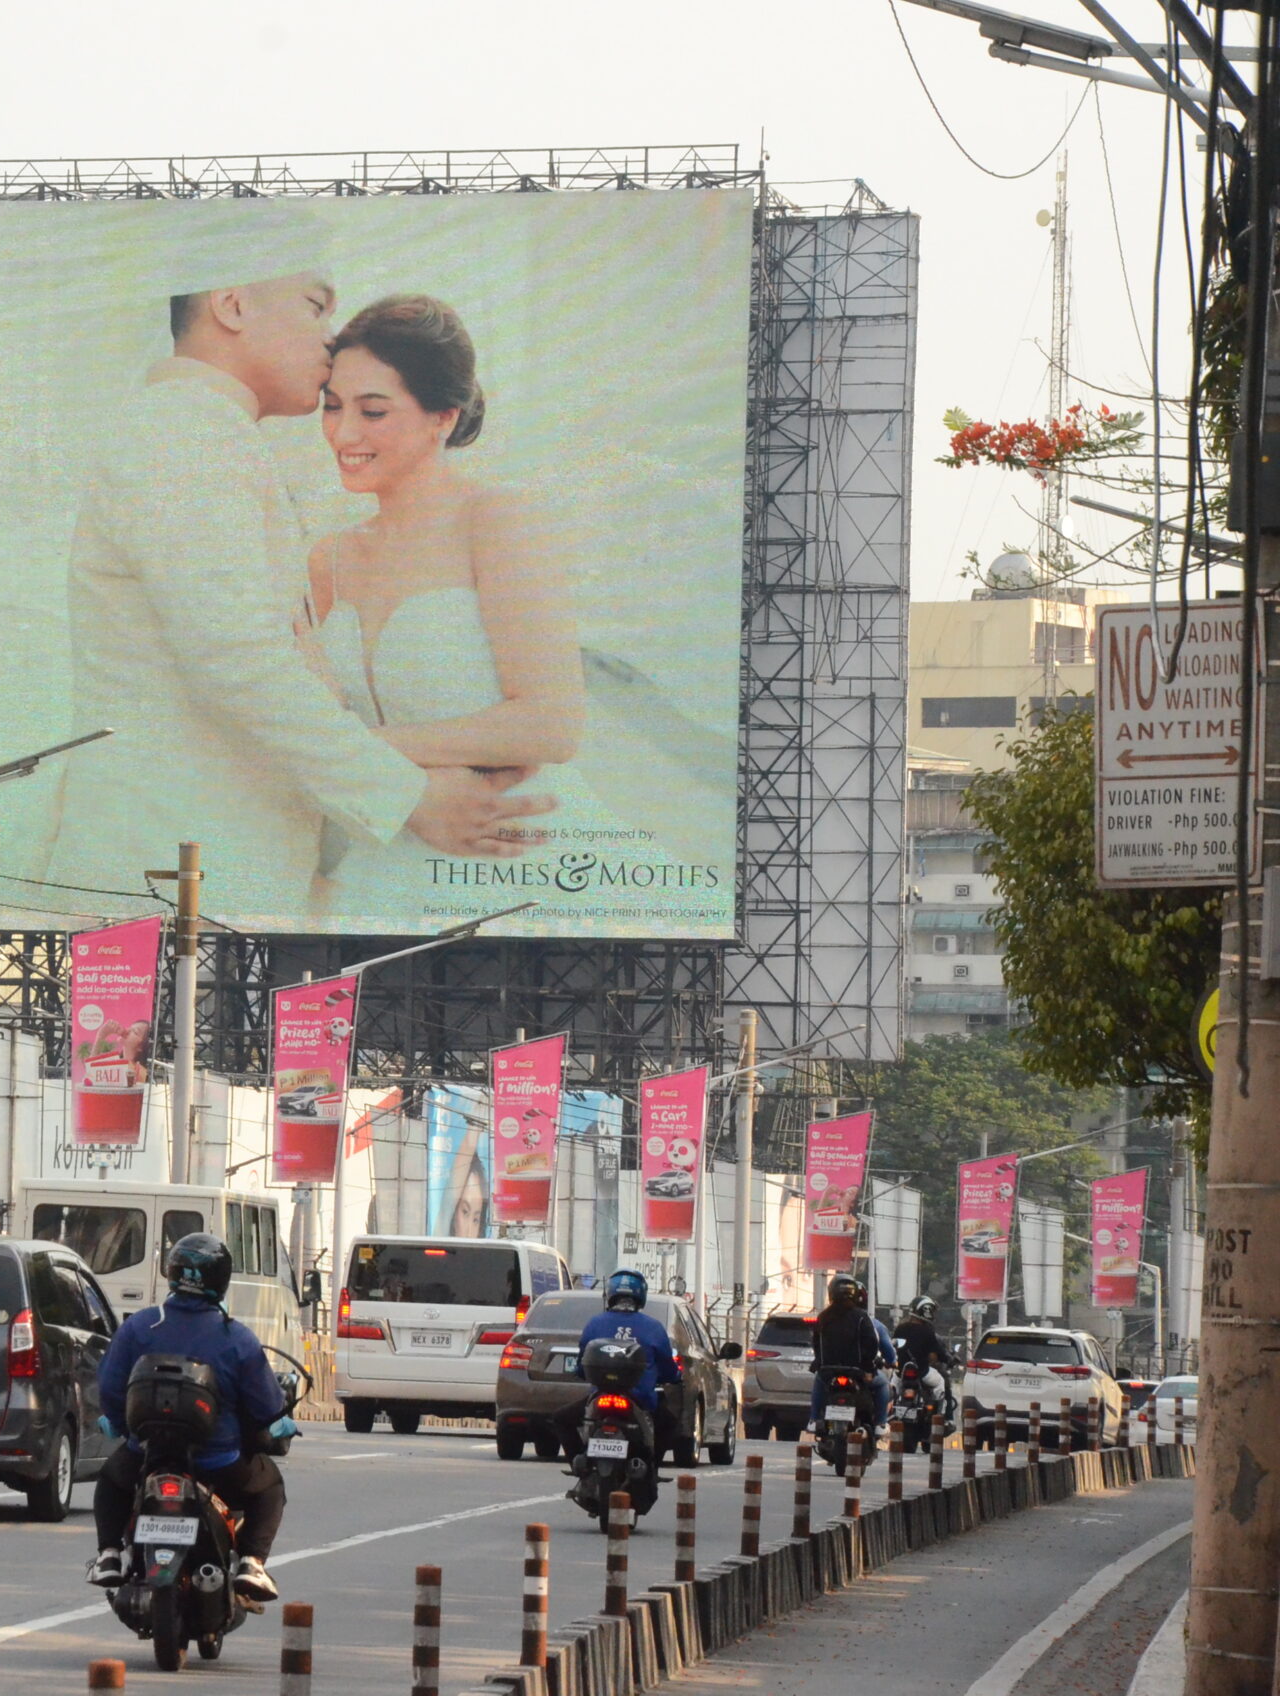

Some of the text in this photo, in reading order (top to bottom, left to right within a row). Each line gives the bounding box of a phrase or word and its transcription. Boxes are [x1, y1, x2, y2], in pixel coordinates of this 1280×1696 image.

[1109, 624, 1157, 711] NO
[1164, 654, 1240, 677] UNLOADIN
[1116, 719, 1242, 741] ANYTIME
[1108, 787, 1226, 806] VIOLATION FINE:
[1108, 815, 1152, 830] DRIVER
[499, 828, 556, 839] Produced
[560, 829, 569, 839] &
[572, 828, 635, 842] Organized
[1108, 843, 1164, 859] JAYWALKING
[425, 853, 718, 892] THEMES & MOTIFS
[450, 905, 478, 916] bride
[1207, 1228, 1252, 1254] POST
